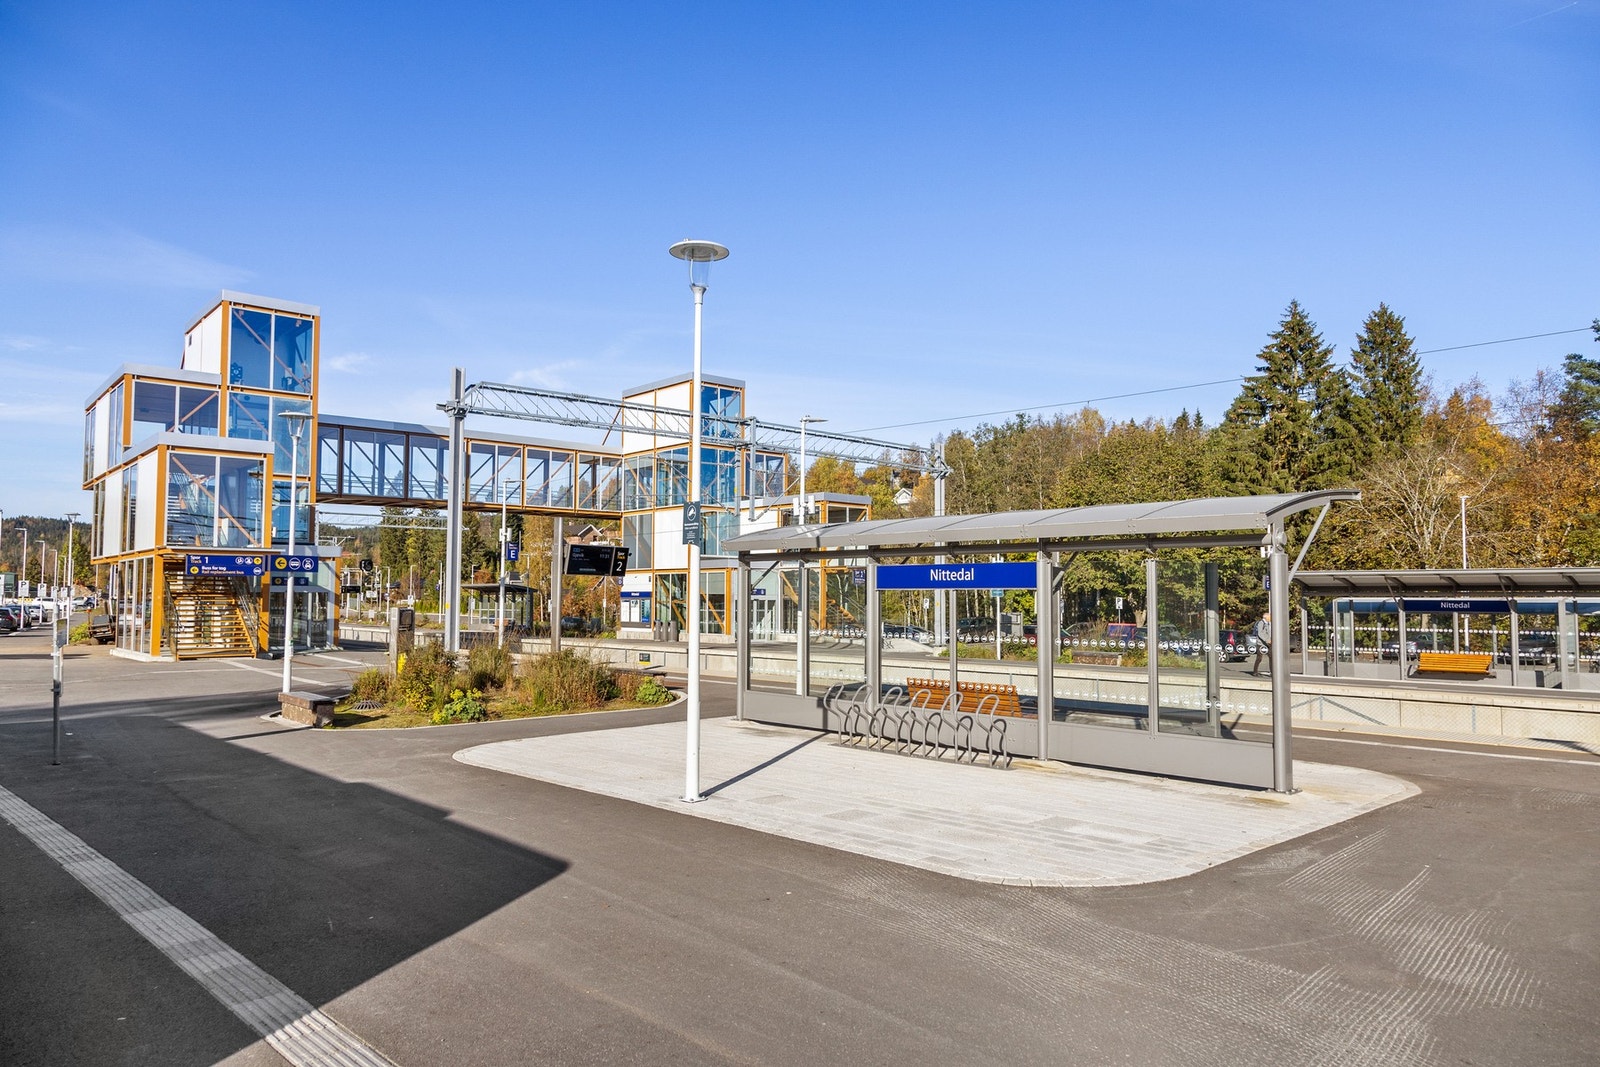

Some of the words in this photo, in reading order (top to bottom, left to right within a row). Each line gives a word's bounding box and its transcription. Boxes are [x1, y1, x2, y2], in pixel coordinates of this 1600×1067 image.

[510, 550, 516, 558] E
[204, 556, 209, 564] 1
[616, 561, 623, 572] 2
[930, 567, 975, 581] Nittedal
